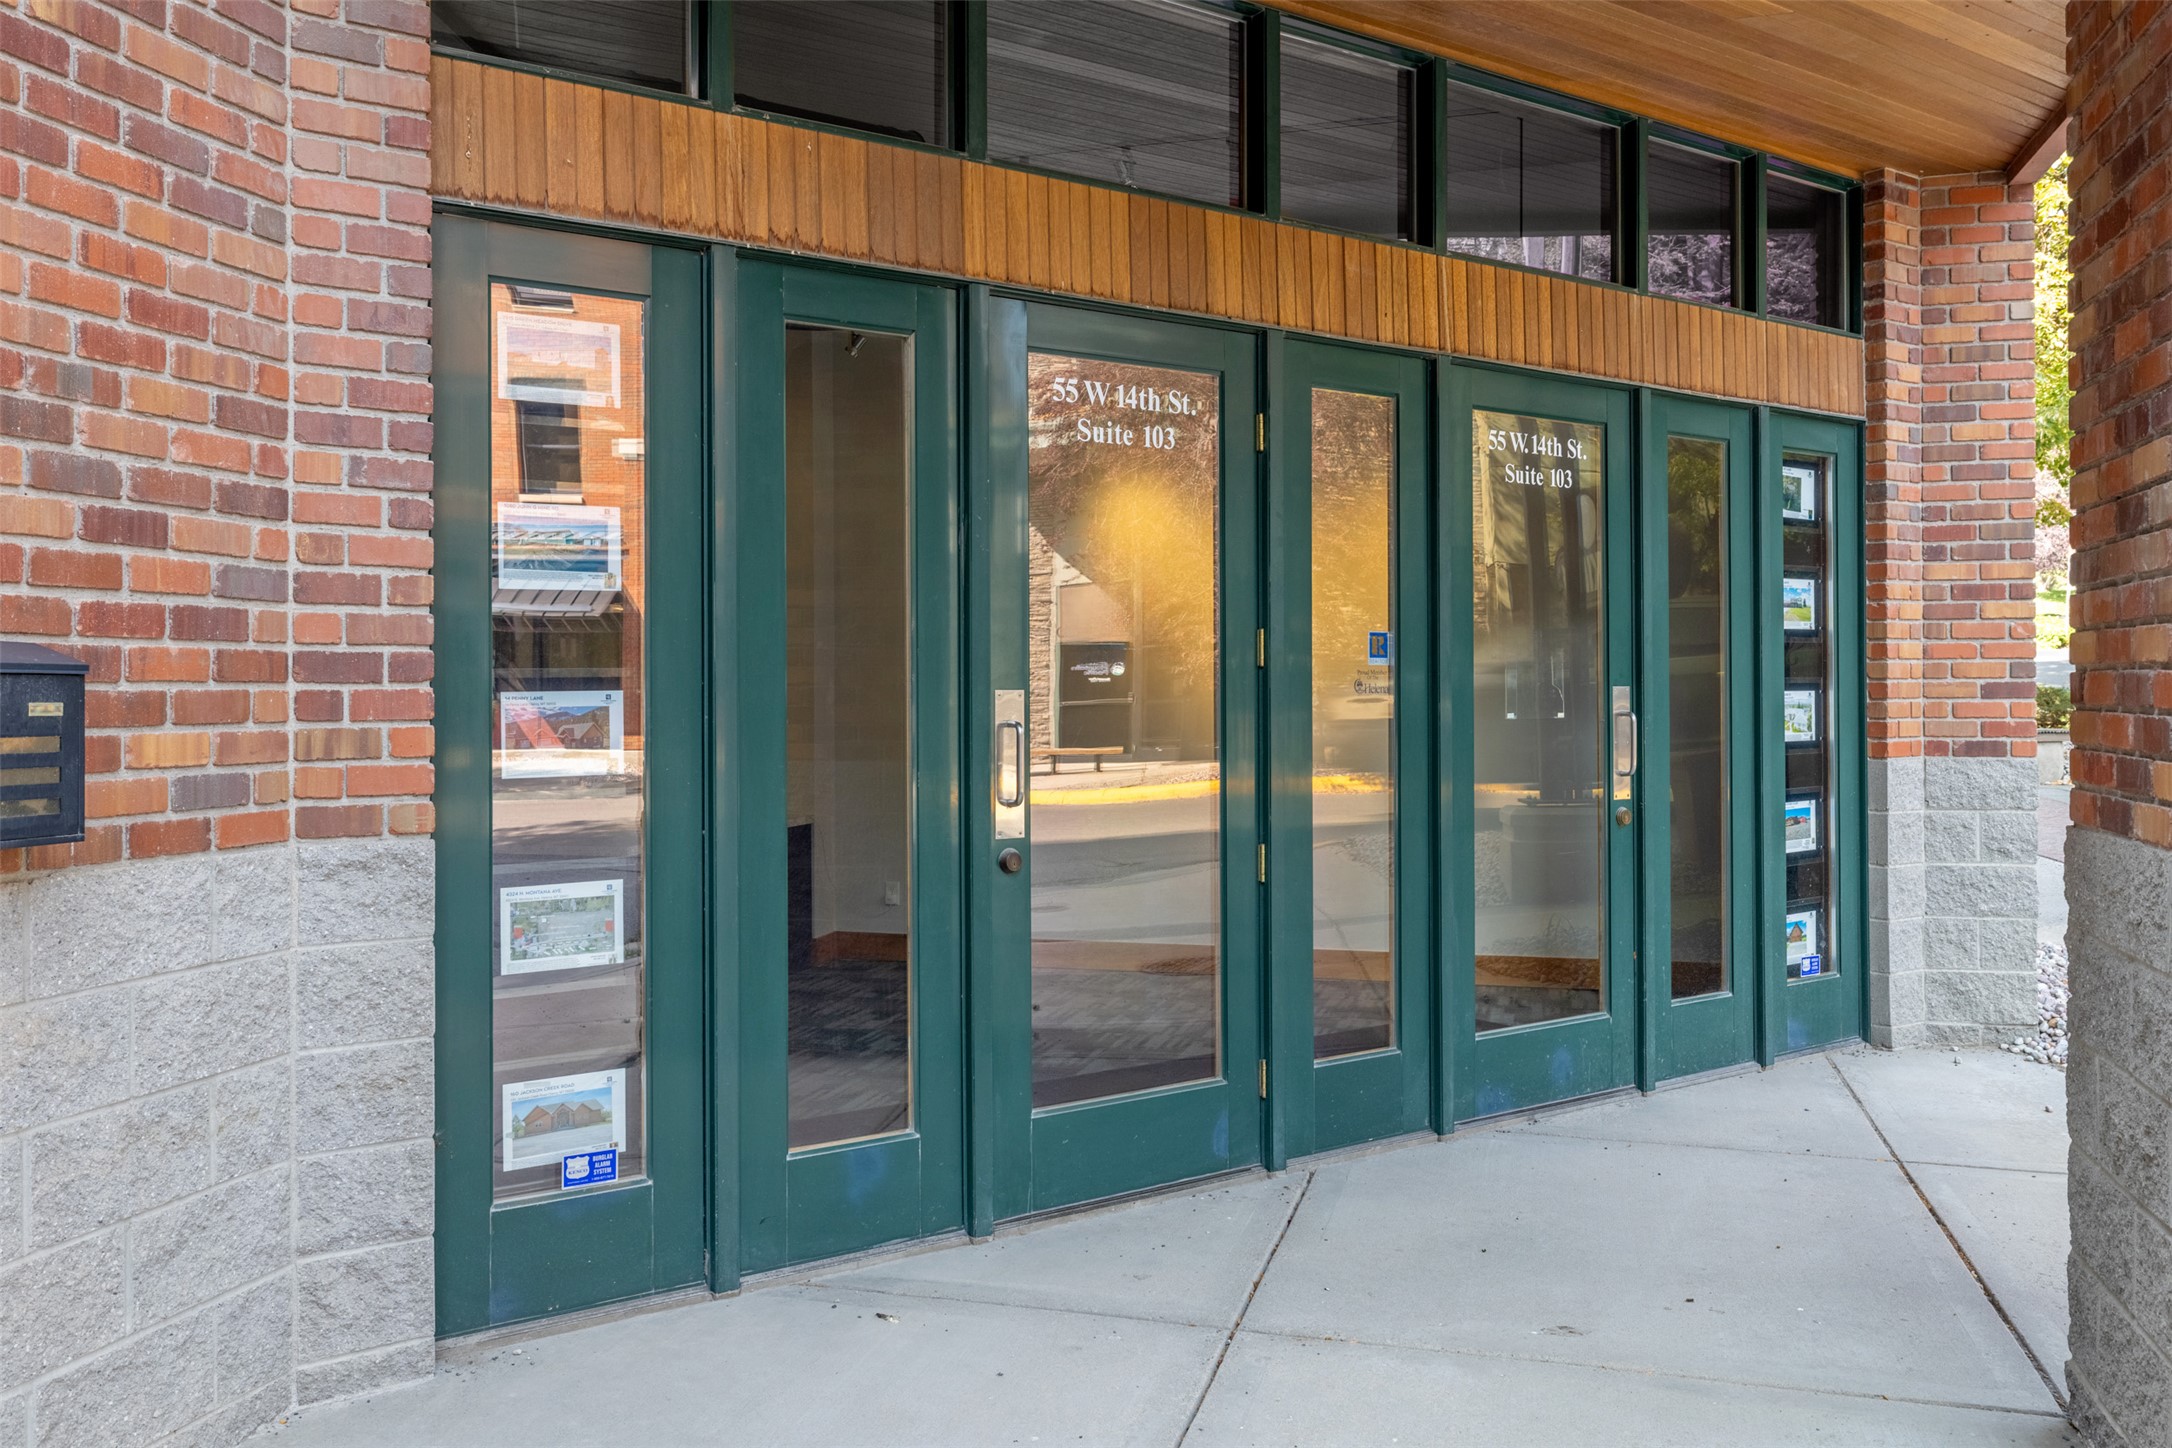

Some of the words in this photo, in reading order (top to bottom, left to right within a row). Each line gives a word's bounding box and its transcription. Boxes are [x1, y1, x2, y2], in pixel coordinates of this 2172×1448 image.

[1052, 377, 1079, 403] 55
[1084, 380, 1111, 406] W
[1116, 384, 1161, 412] 14th
[1168, 389, 1198, 416] St.
[1077, 418, 1134, 446] Suite
[1143, 426, 1176, 449] 103
[1488, 429, 1507, 451] 55
[1509, 432, 1529, 454] W.
[1531, 434, 1563, 458] 14th
[1567, 438, 1588, 460] St.
[1505, 463, 1544, 486] Suite
[1550, 468, 1573, 489] 103
[520, 1087, 543, 1096] JACKSON
[592, 1153, 613, 1162] BURGLAR
[594, 1160, 611, 1168] ALARM
[593, 1167, 612, 1175] SYSTEM
